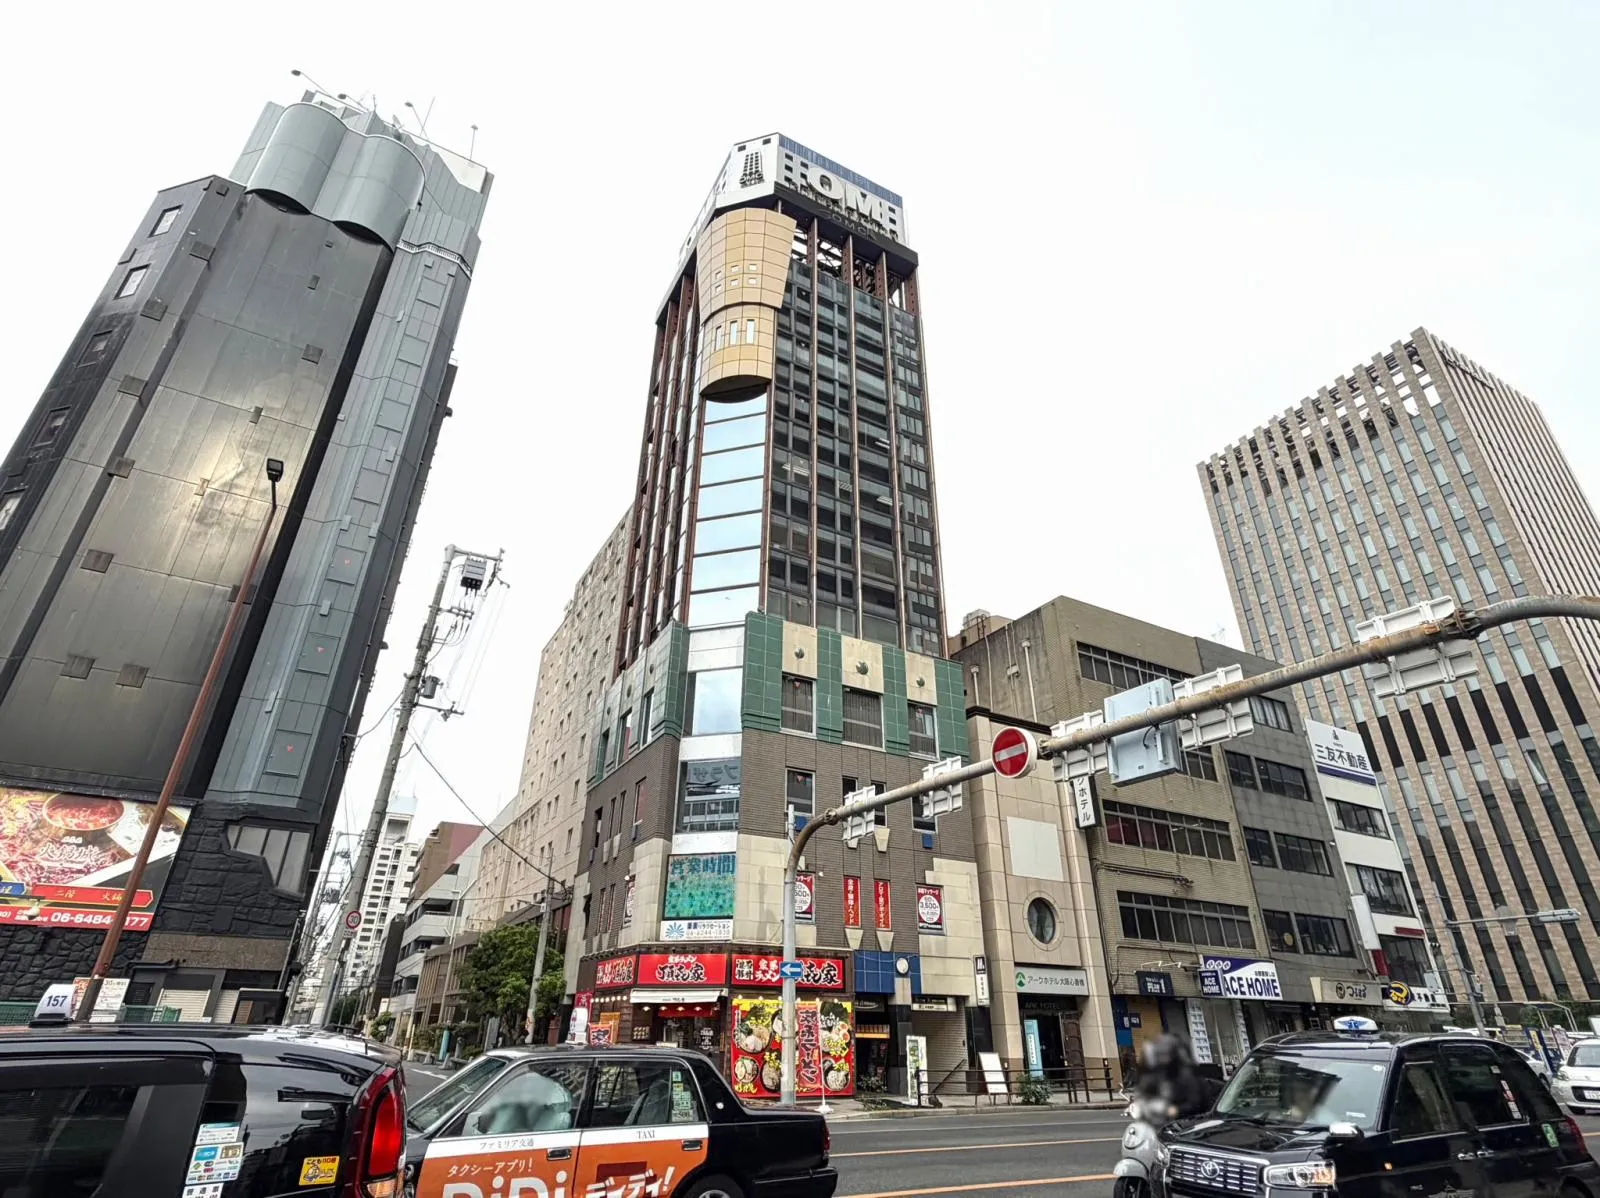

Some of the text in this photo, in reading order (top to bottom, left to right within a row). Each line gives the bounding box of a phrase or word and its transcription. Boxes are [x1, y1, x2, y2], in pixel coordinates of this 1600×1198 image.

[1315, 743, 1370, 771] 三友不動産
[51, 911, 149, 927] 06-6484-177
[1027, 975, 1085, 986] アークホテル大阪心斎橋
[1205, 977, 1216, 985] ACE
[1203, 985, 1220, 994] HOME
[1223, 976, 1280, 998] ACE HOME
[46, 995, 68, 1008] 157
[636, 1129, 656, 1140] TAXI
[480, 1138, 534, 1150] ファミリア交通
[447, 1157, 533, 1178] タクシーアプリ!
